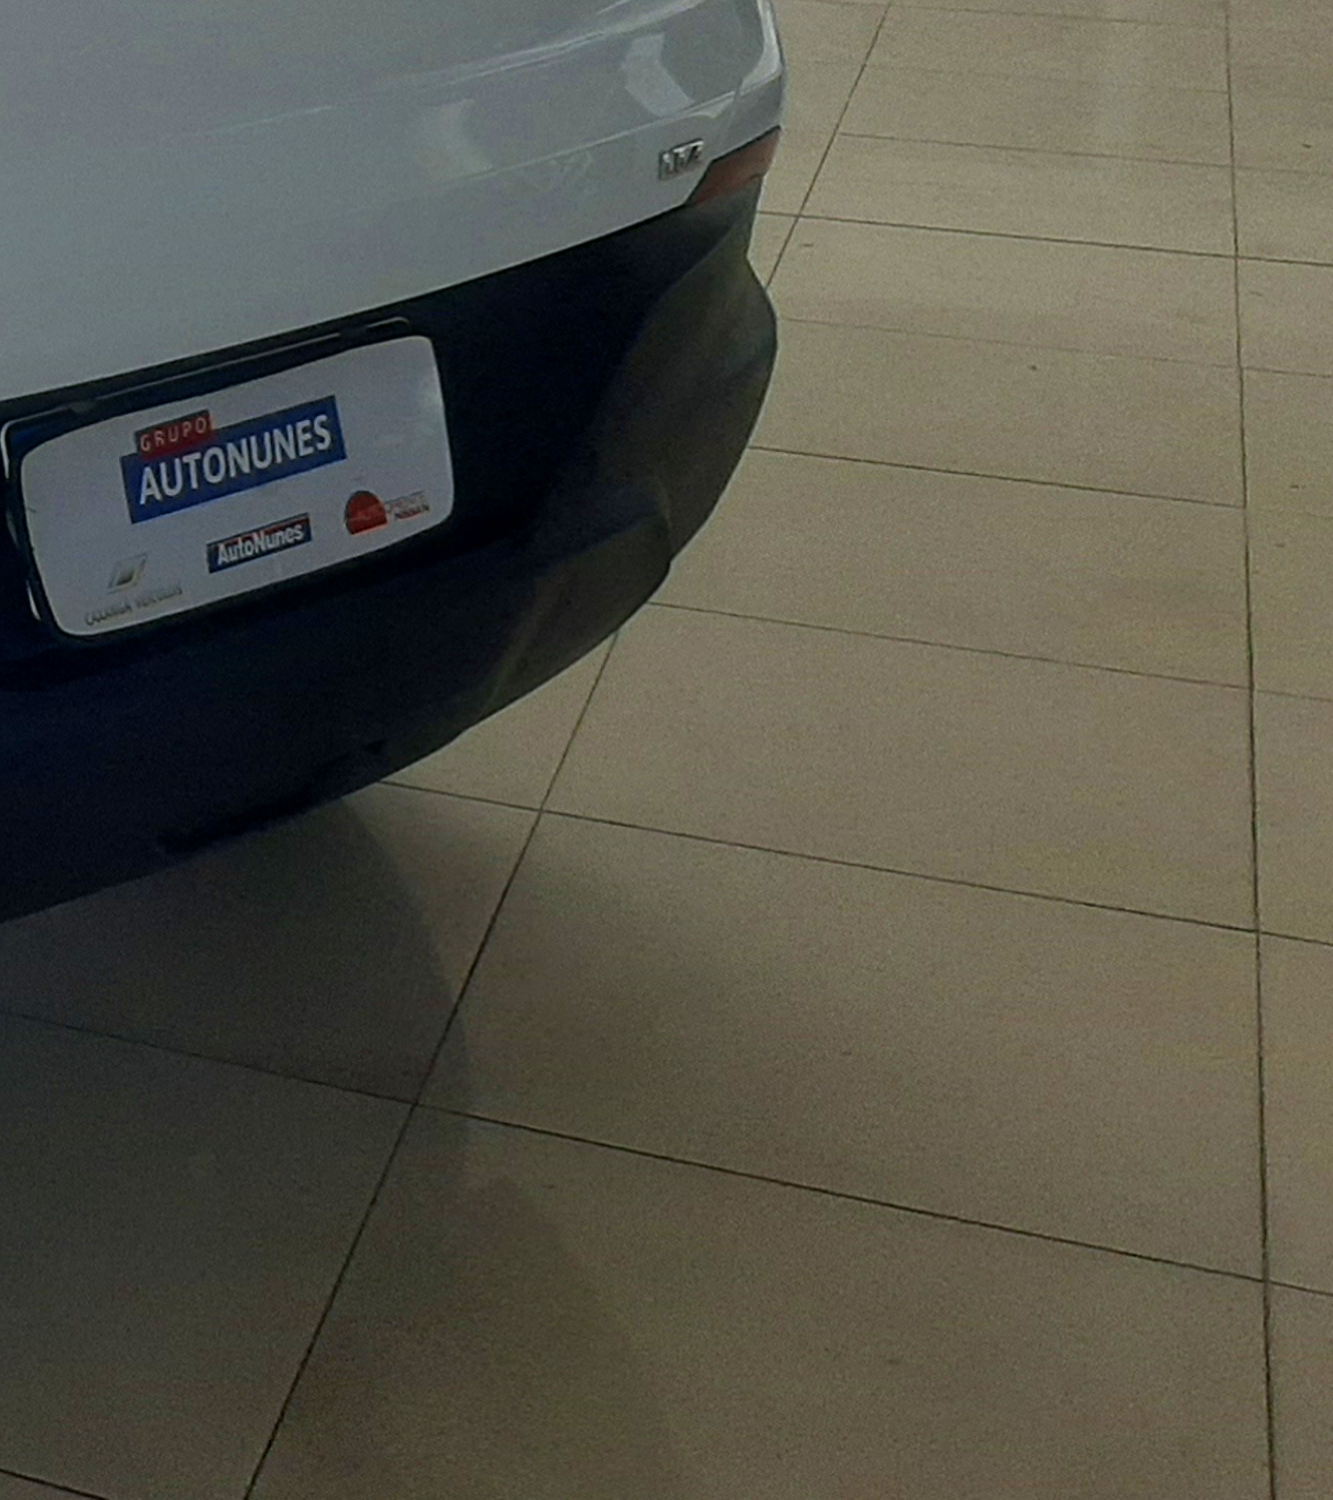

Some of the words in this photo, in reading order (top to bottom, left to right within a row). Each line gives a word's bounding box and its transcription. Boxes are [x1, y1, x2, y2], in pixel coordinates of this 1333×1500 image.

[139, 416, 209, 453] GRUPO
[138, 413, 332, 506] AUTONUNES
[215, 523, 305, 566] AutoNunes
